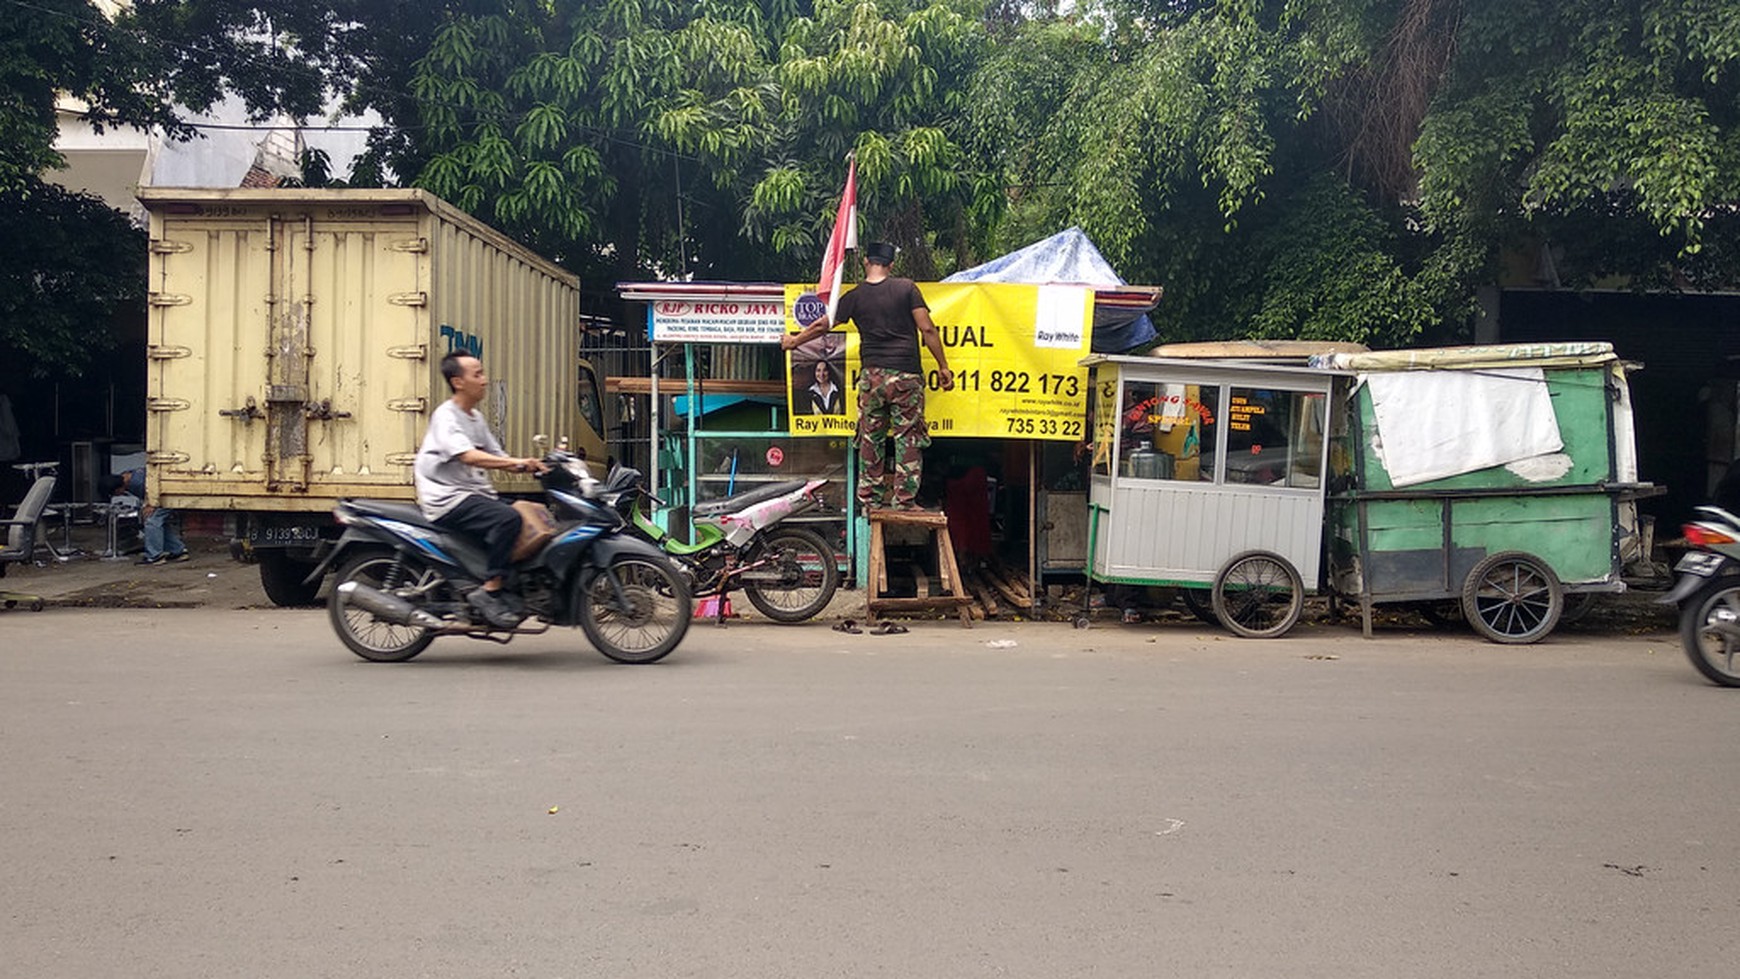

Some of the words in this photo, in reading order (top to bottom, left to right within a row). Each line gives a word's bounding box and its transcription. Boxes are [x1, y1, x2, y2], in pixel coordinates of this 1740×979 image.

[663, 303, 685, 313] RJP
[695, 304, 739, 314] RICKO
[744, 304, 777, 315] JAYA
[797, 302, 823, 313] TOP
[1038, 330, 1054, 343] Ray
[1055, 331, 1079, 342] White
[990, 371, 1030, 392] 822
[1038, 373, 1079, 397] 173
[796, 419, 818, 432] Ray
[822, 417, 855, 431] White
[1007, 417, 1034, 434] 735
[1040, 419, 1057, 435] 33
[1062, 420, 1081, 436] 22
[266, 528, 290, 540] 9139
